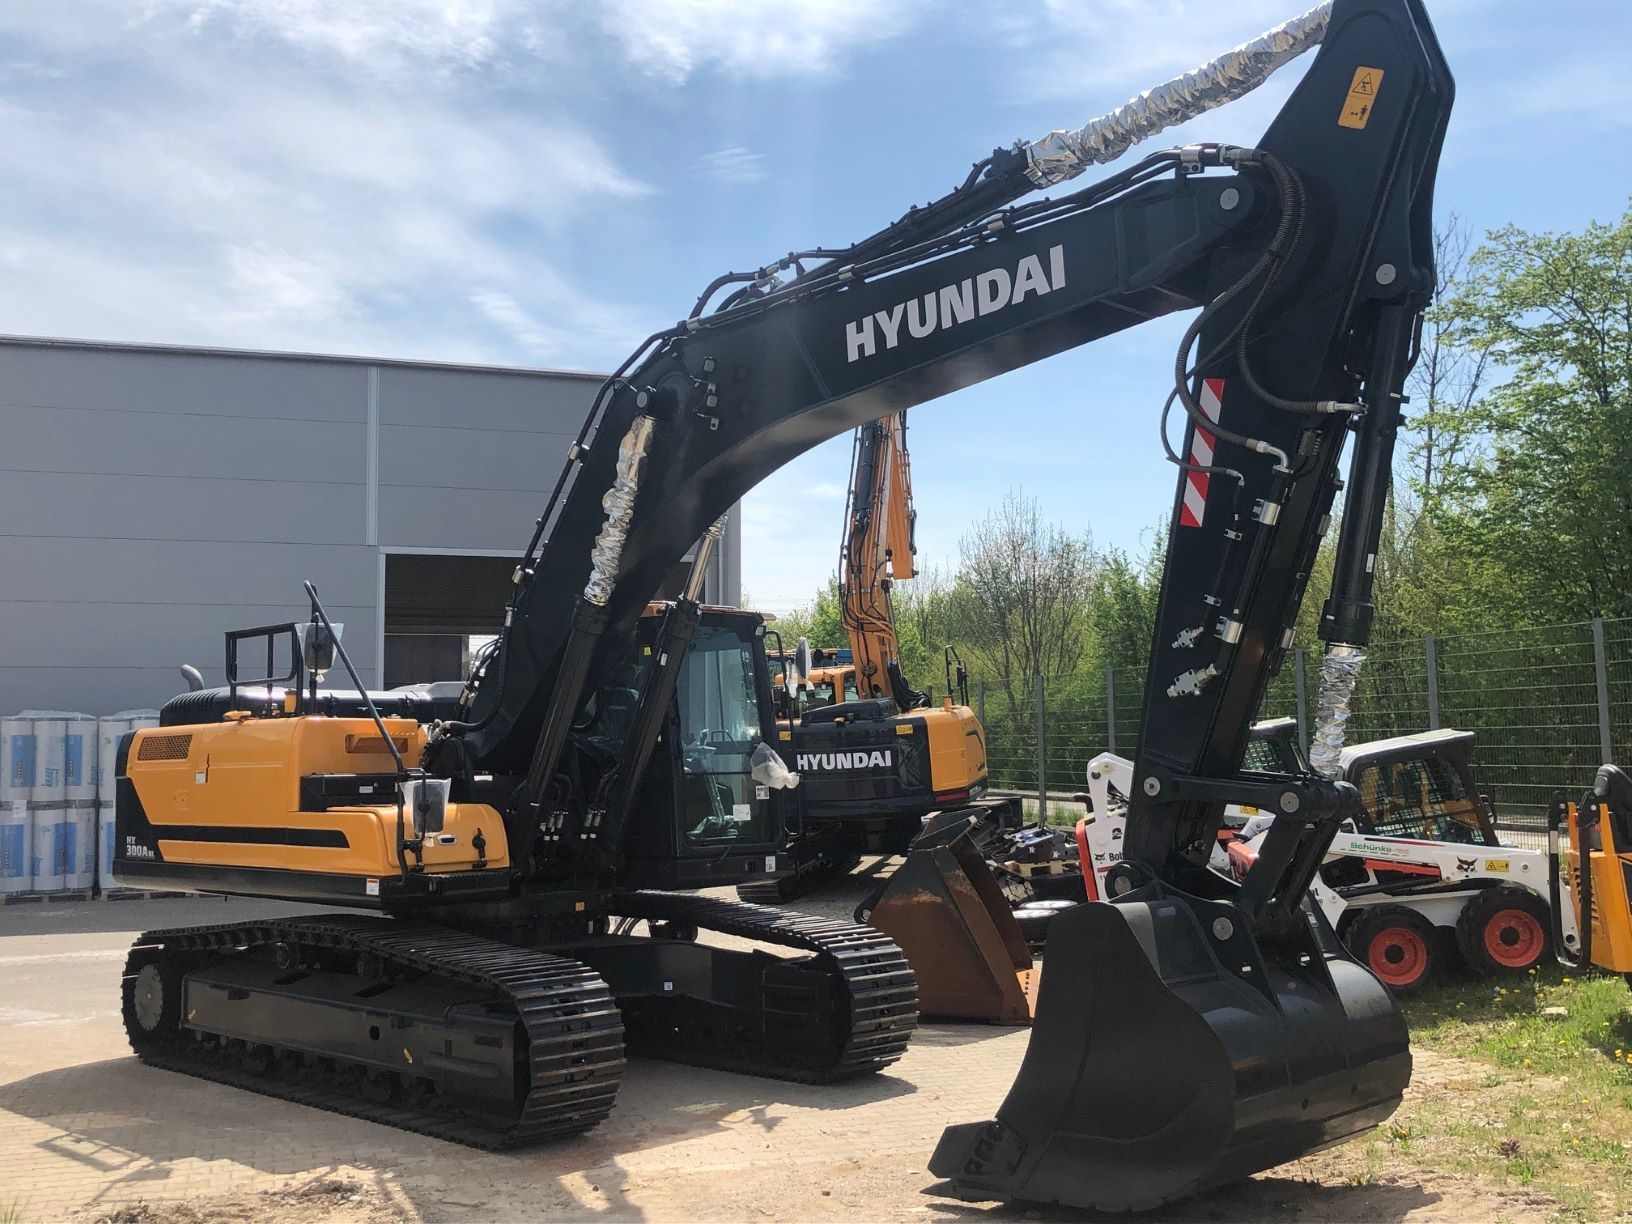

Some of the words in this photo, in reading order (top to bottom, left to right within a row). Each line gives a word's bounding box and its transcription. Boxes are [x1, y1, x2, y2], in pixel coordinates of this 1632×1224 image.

[845, 244, 1066, 363] HYUNDAI
[797, 750, 892, 770] HYUNDAI
[126, 836, 136, 844] HX
[126, 845, 148, 857] 300A
